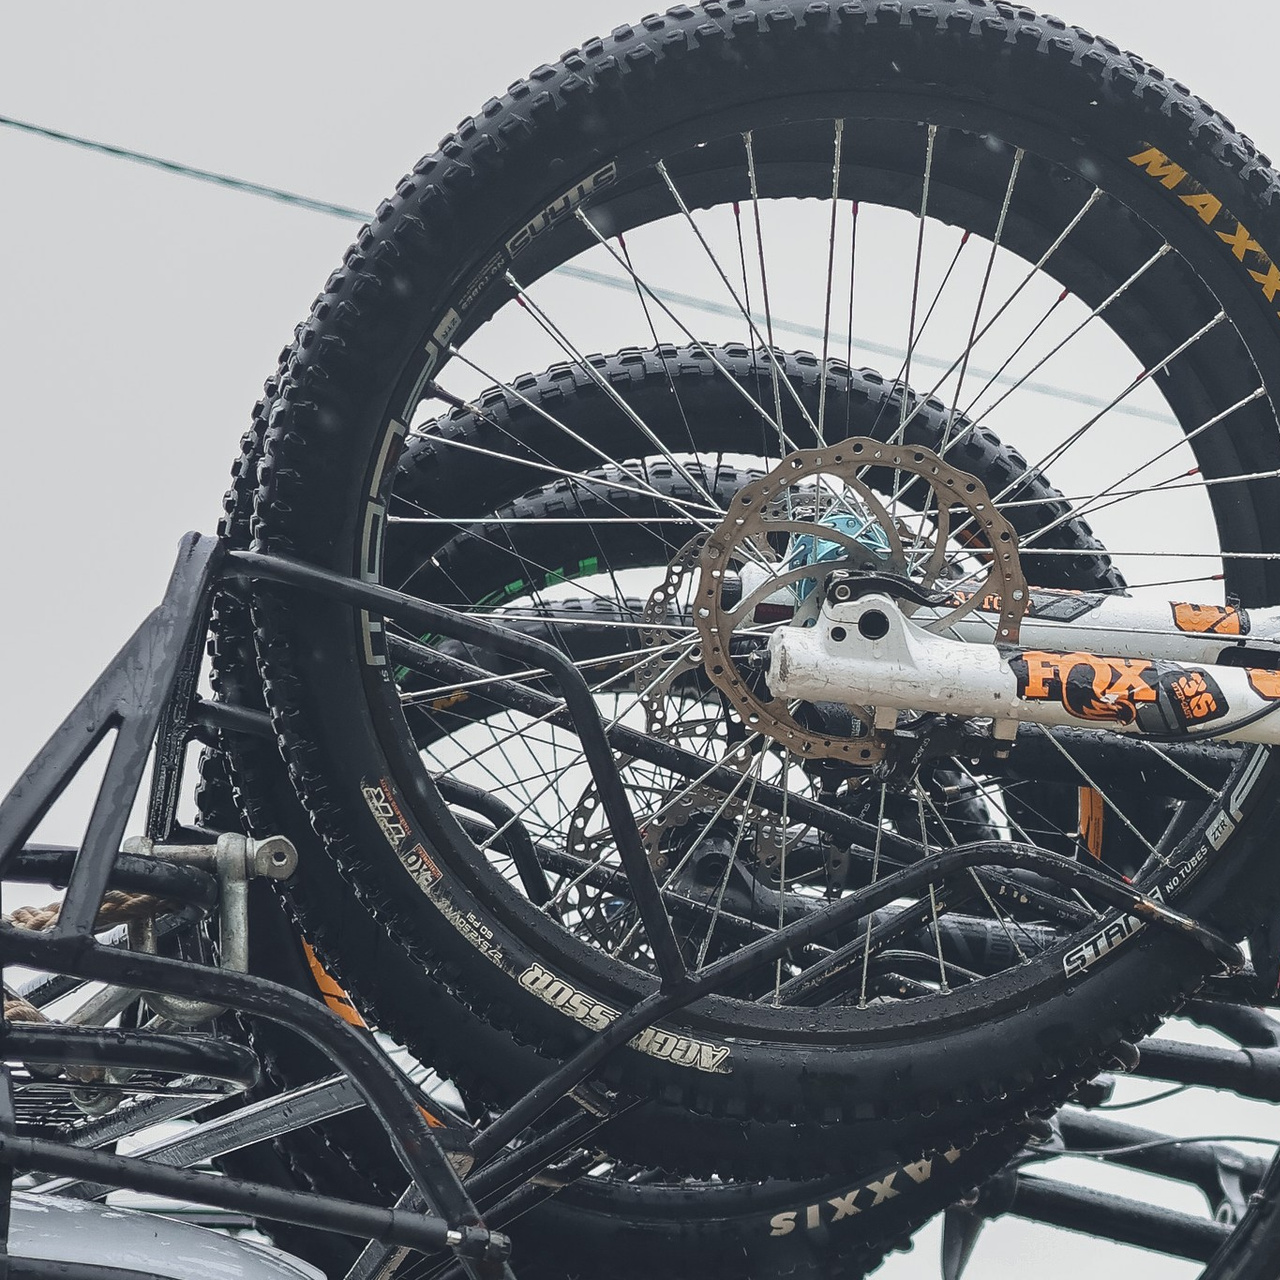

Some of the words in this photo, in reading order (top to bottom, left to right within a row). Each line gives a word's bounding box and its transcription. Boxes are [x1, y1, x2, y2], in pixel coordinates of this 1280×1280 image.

[1022, 651, 1157, 713] FOX
[1180, 672, 1219, 719] 36
[1211, 818, 1229, 842] ZTR
[1165, 876, 1179, 894] NO
[1179, 845, 1209, 879] TUBES
[466, 912, 480, 929] PSI
[479, 925, 494, 940] 60
[1064, 887, 1164, 977] STA
[517, 963, 733, 1073] AGGSSOR
